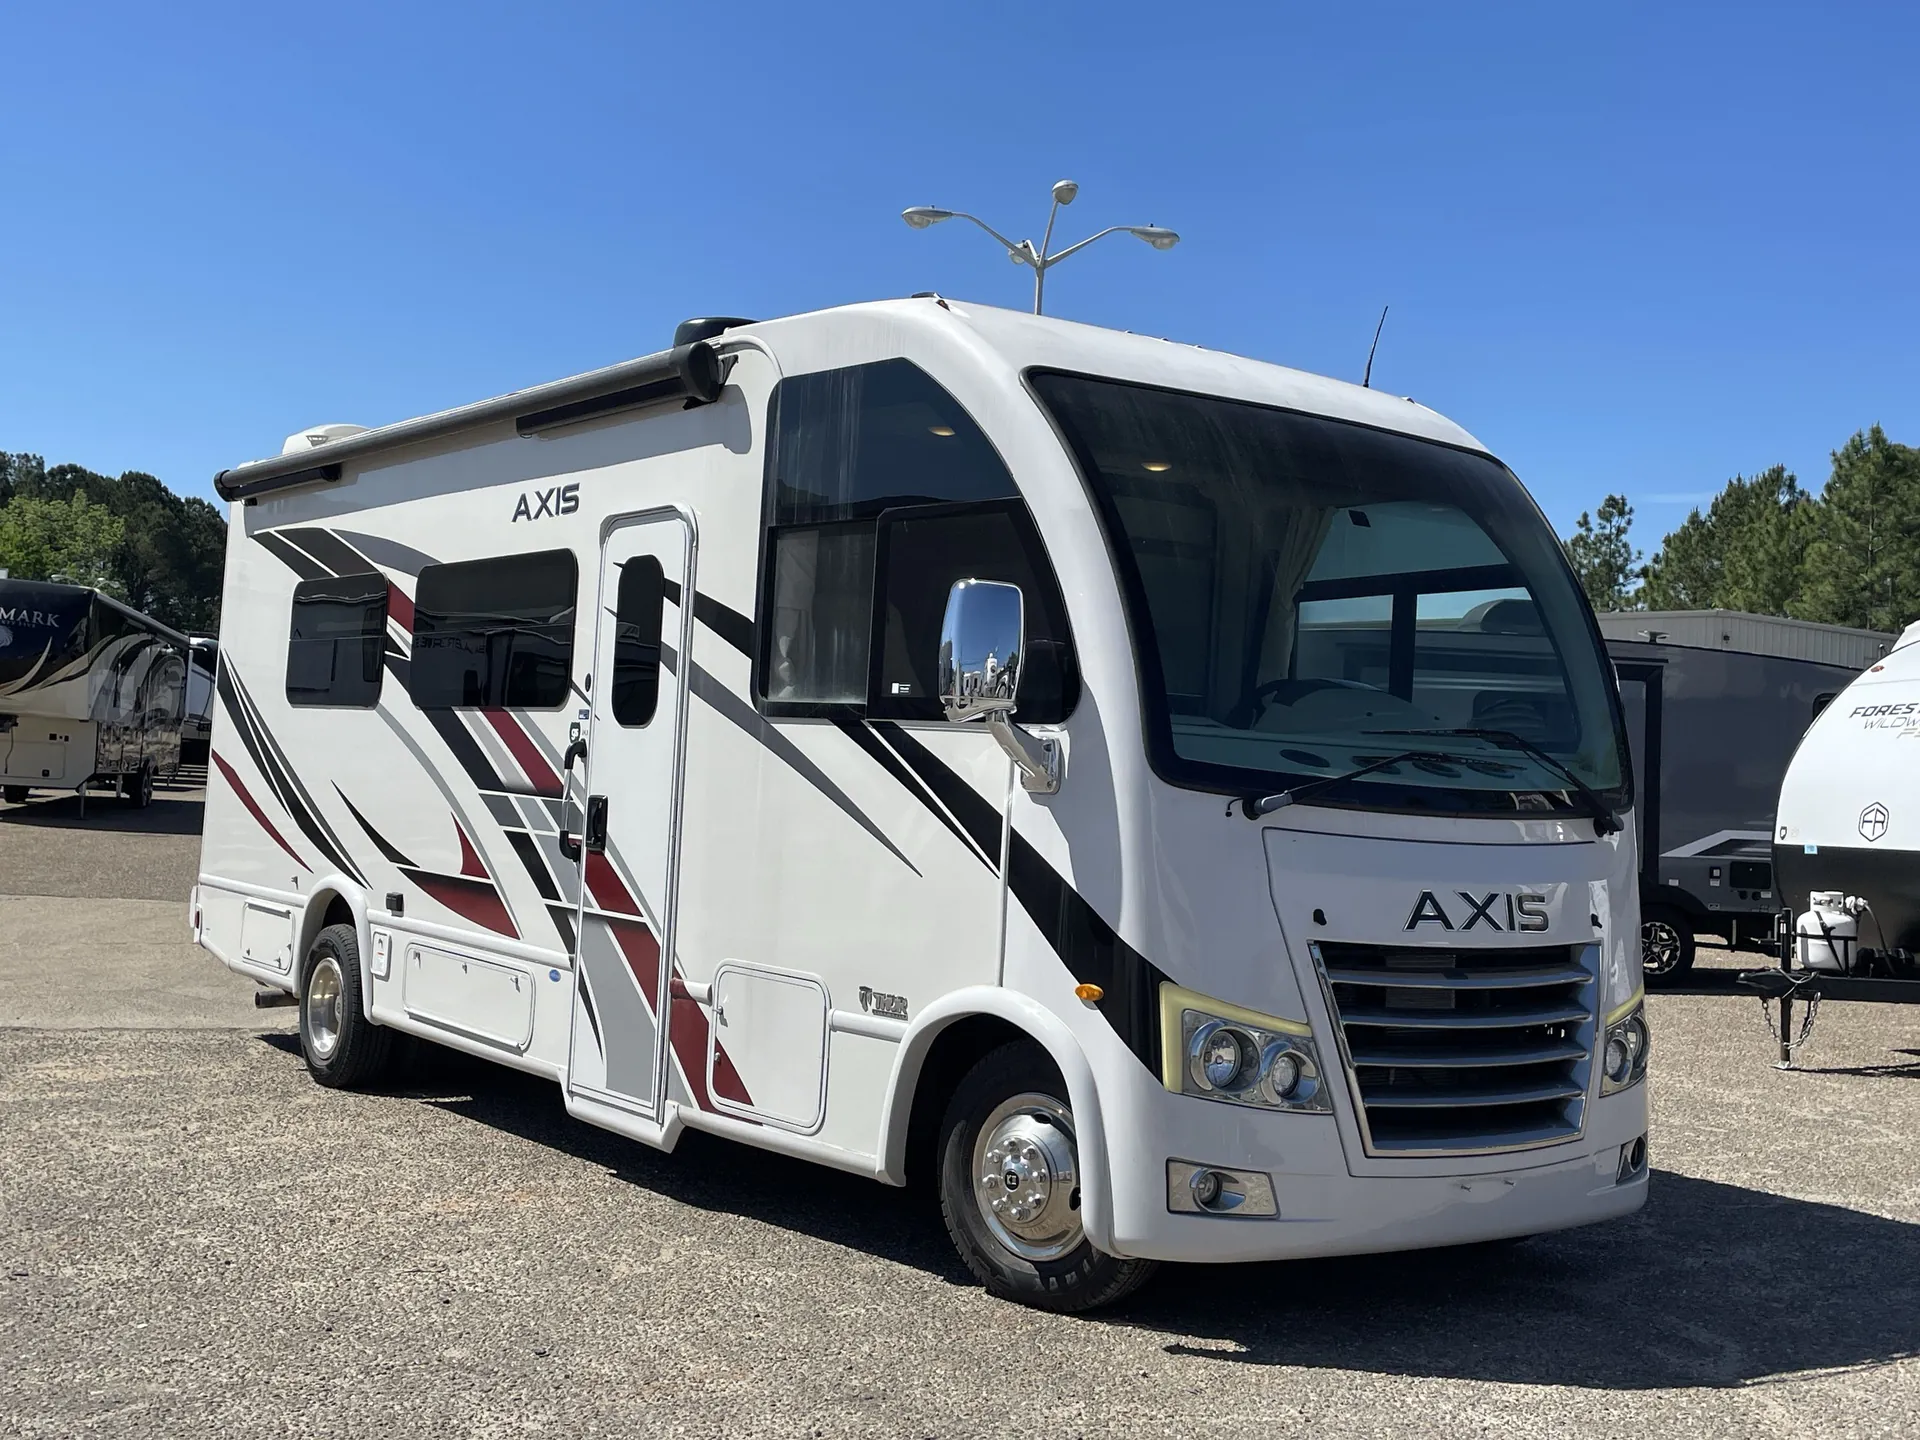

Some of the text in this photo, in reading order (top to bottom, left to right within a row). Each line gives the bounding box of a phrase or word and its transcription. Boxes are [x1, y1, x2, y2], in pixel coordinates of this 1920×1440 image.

[511, 482, 580, 523] AXIS
[0, 606, 60, 628] MARK
[1848, 702, 1920, 718] FORES
[1402, 889, 1549, 934] AXIS
[872, 991, 908, 1015] THOR
